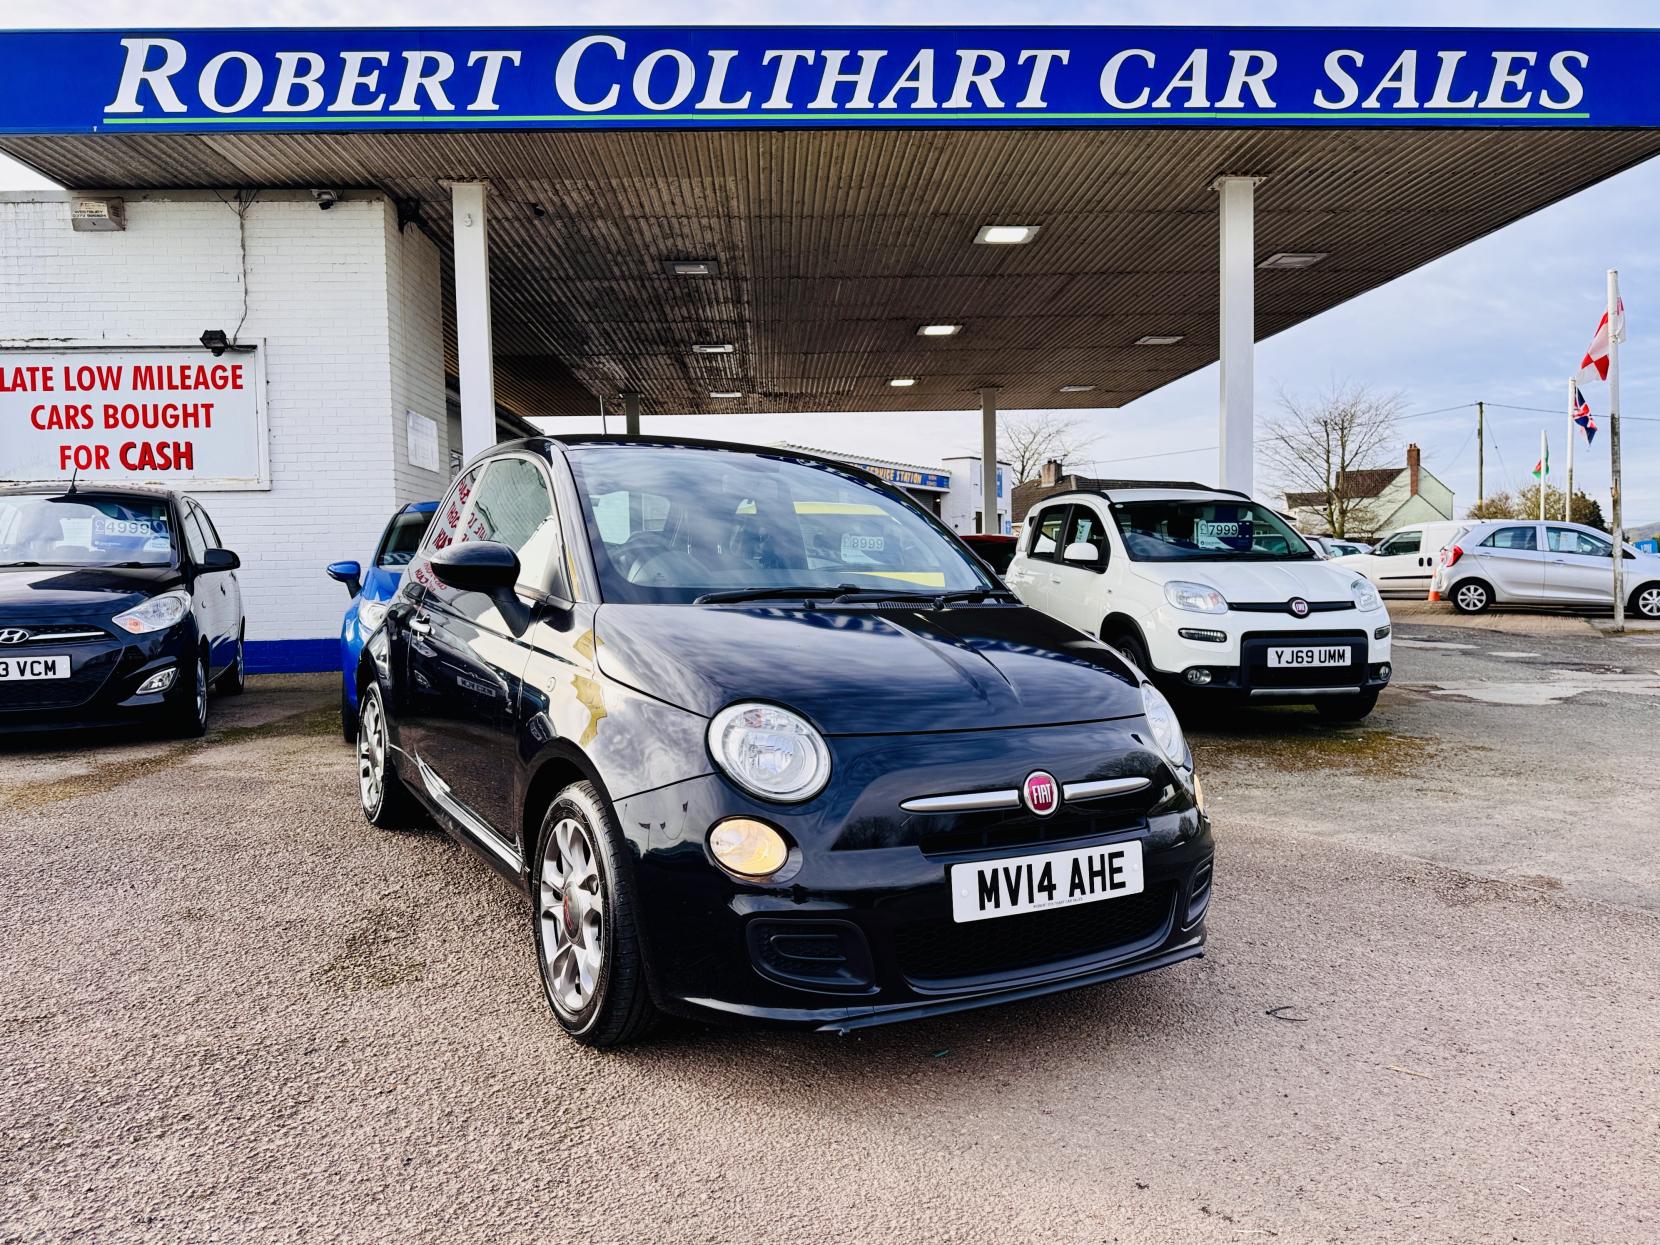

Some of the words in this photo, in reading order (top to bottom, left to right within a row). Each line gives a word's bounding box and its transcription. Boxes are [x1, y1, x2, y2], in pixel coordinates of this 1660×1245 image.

[103, 37, 522, 114] ROBERT
[555, 35, 1070, 112] COLTHART
[1099, 48, 1278, 110] CAR
[1313, 48, 1590, 110] SALES
[0, 366, 54, 392] LATE
[64, 365, 123, 391] LOW
[132, 364, 244, 391] MILEAGE
[30, 404, 94, 430] CARS
[103, 403, 215, 429] BOUGHT
[59, 444, 110, 471] FOR
[119, 441, 194, 471] CASH
[896, 469, 922, 485] STATION
[16, 660, 57, 677] VCM
[1275, 649, 1314, 664] YJ69
[1318, 649, 1346, 664] UMM
[1031, 783, 1053, 805] FIAT
[977, 861, 1057, 911] MV14
[1068, 851, 1127, 898] AHE
